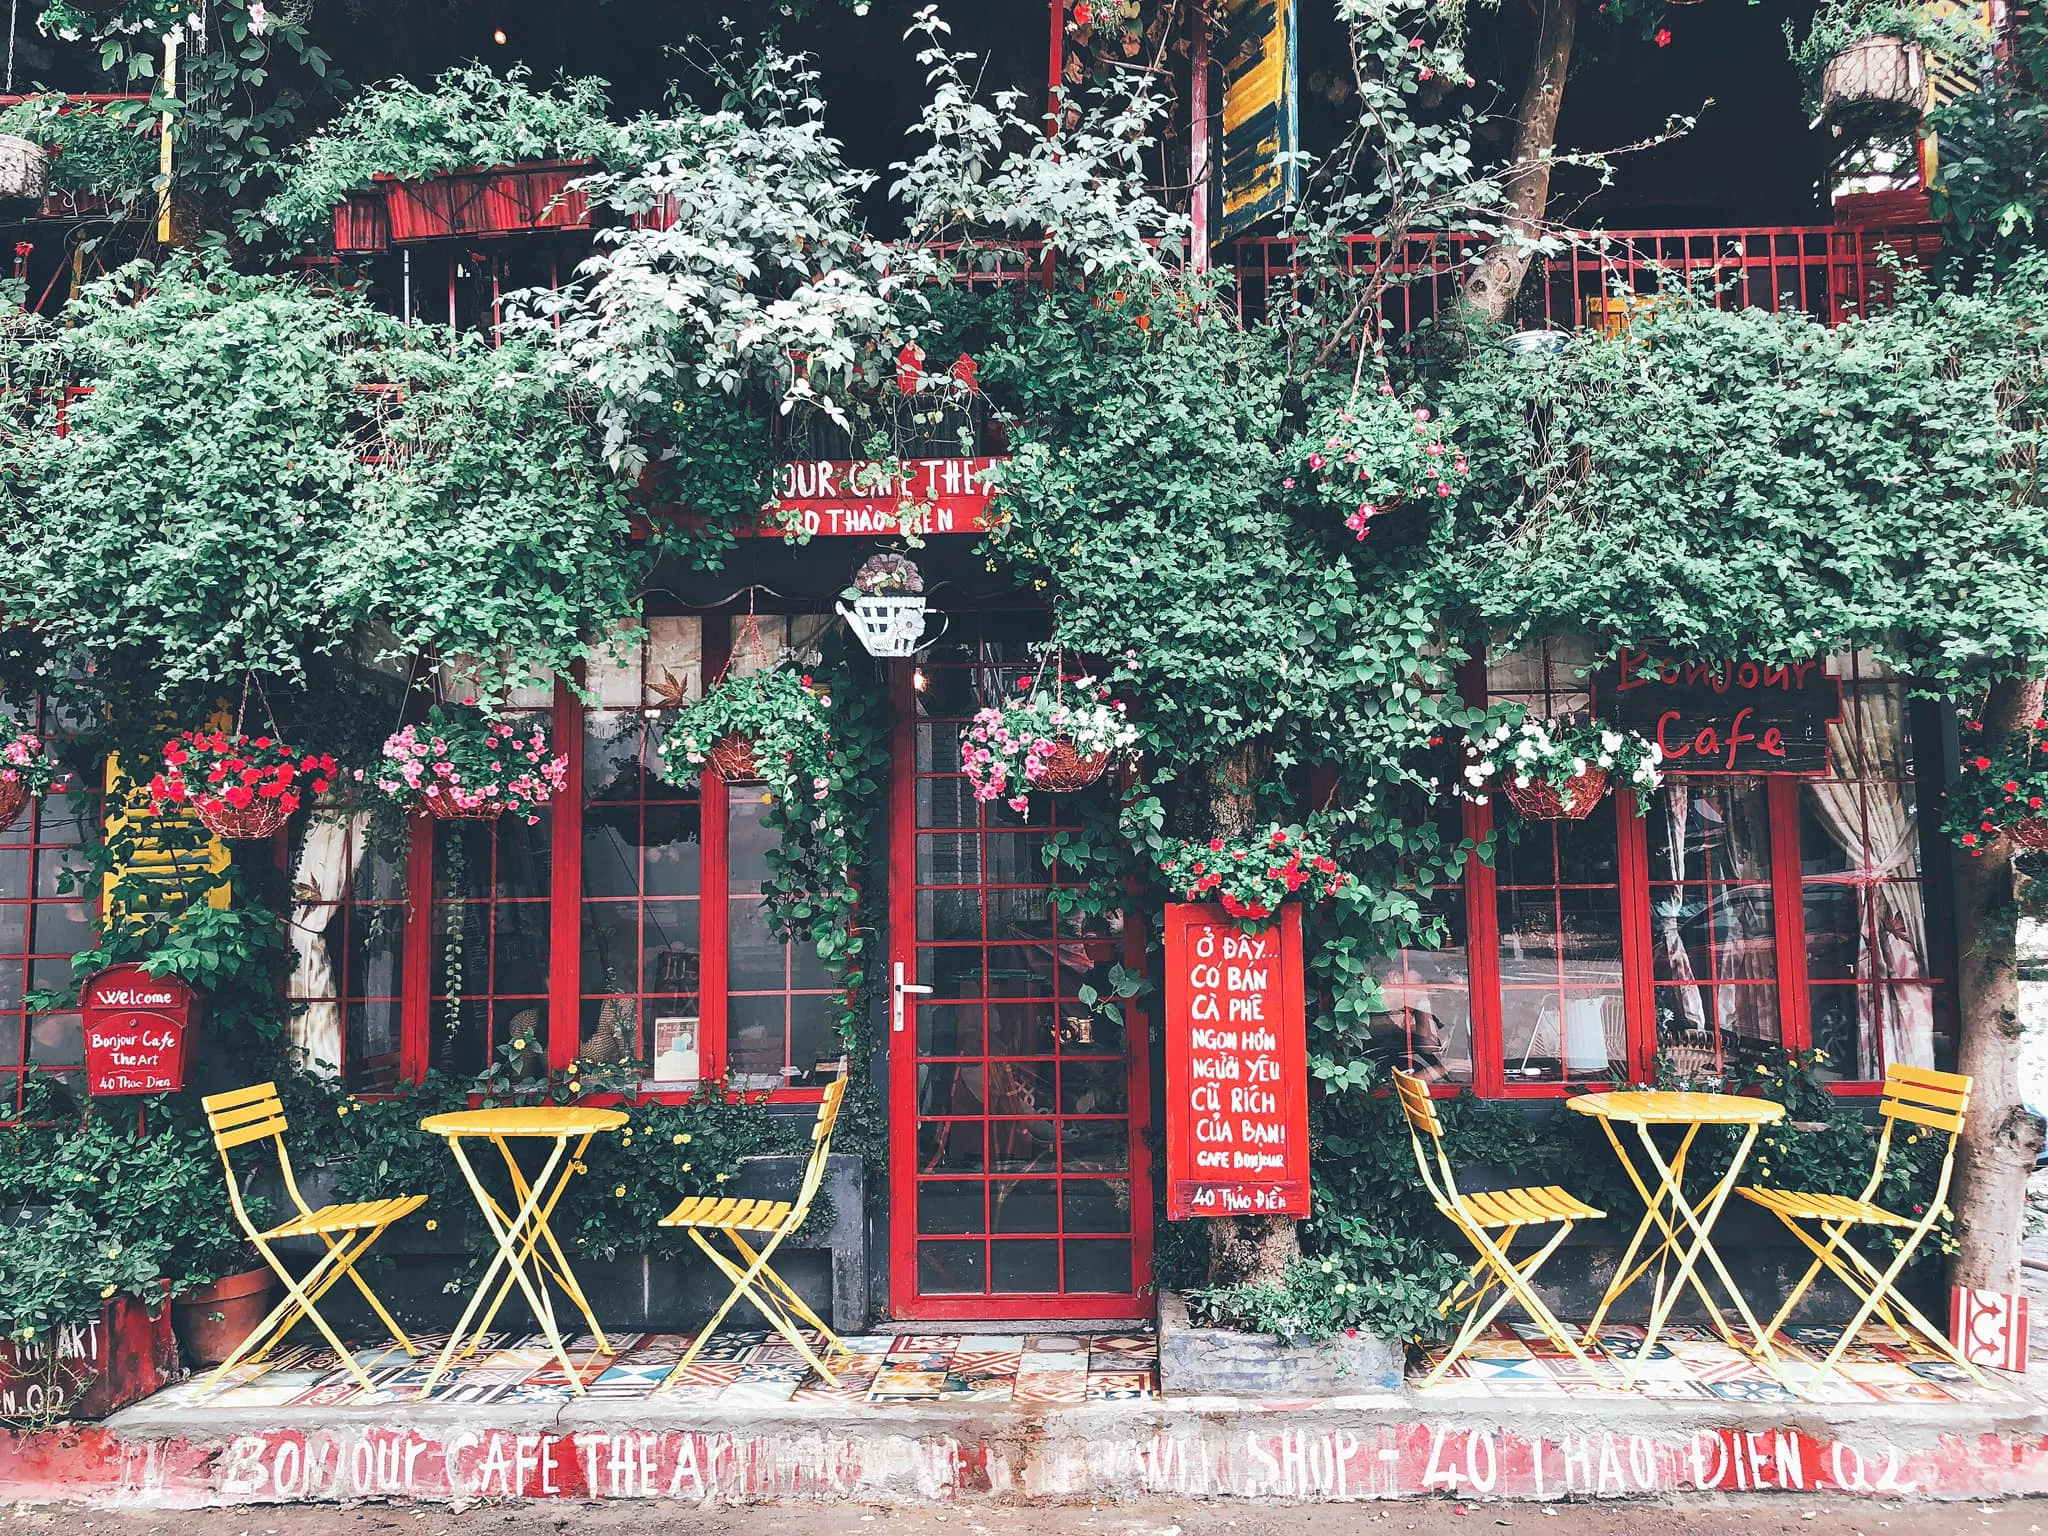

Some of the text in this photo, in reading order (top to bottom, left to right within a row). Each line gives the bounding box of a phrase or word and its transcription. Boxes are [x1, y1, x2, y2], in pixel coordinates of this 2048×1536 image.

[920, 460, 974, 495] THE
[1656, 707, 1785, 770] Cafe
[1197, 926, 1215, 957] Ở
[1191, 961, 1267, 992] CÓ BÁN
[97, 989, 171, 1005] Welcome
[1192, 993, 1264, 1021] CÀ PHÊ
[92, 1030, 175, 1051] Bonjour Cafe
[1192, 1027, 1275, 1050] NGON HƠN
[137, 1054, 158, 1066] Art
[1246, 1054, 1280, 1082] YÊU
[99, 1076, 115, 1089] 40
[1191, 1082, 1221, 1111] CŨ
[1196, 1113, 1285, 1147] CỦA BẠN!
[1197, 1150, 1229, 1168] CAFE
[1191, 1187, 1215, 1206] 40
[1218, 1186, 1251, 1211] THẢO
[446, 1431, 559, 1497] CAFE
[584, 1434, 658, 1499] THE
[1246, 1427, 1358, 1497] SHOP
[1421, 1428, 1497, 1493] 40
